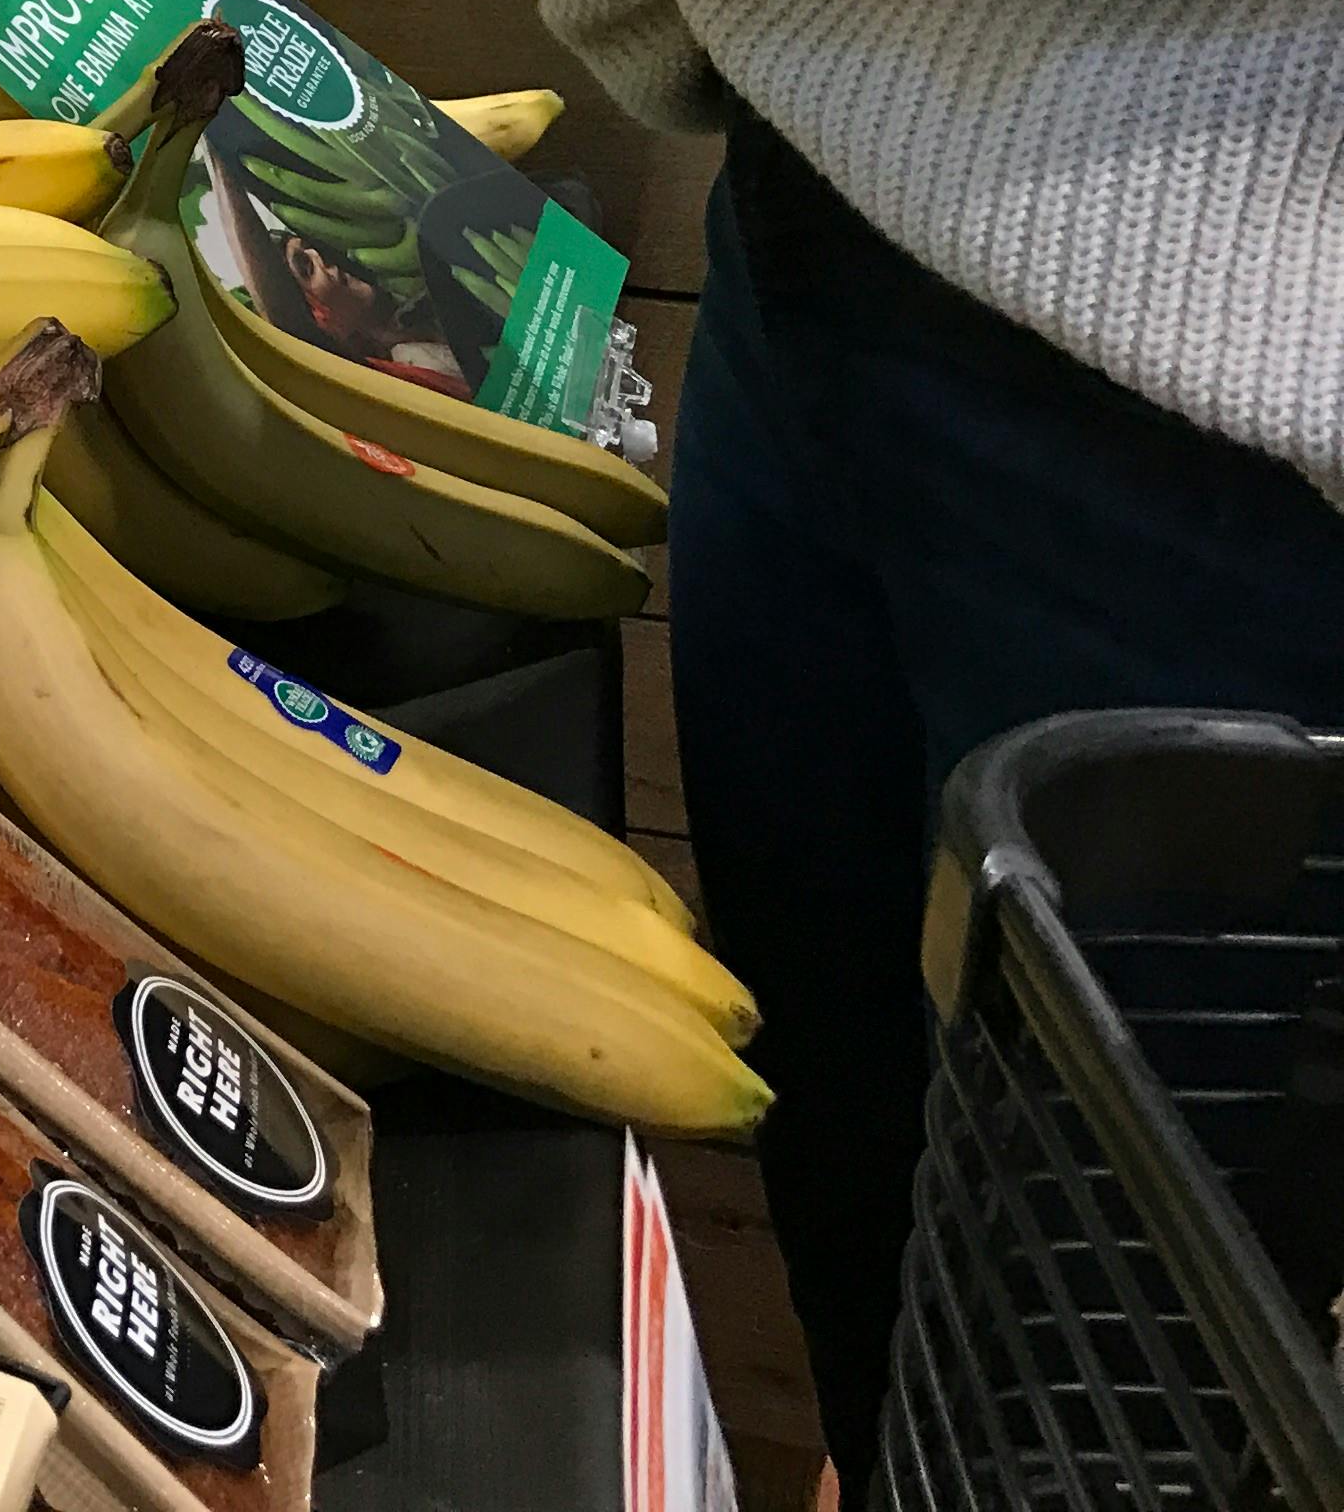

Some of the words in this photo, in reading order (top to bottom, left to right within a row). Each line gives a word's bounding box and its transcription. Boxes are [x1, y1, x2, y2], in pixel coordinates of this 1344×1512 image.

[50, 73, 96, 125] ONE
[74, 10, 140, 88] BANANA
[244, 10, 291, 78] WHOLE
[266, 33, 317, 98] TRADE
[296, 55, 332, 110] GUARANTEE
[167, 1015, 183, 1055] MADE
[175, 1005, 214, 1116] RIGHT
[209, 1037, 242, 1132] HERE
[78, 1223, 94, 1268] MADE
[90, 1211, 128, 1339] RIGHT
[126, 1250, 160, 1359] HERE
